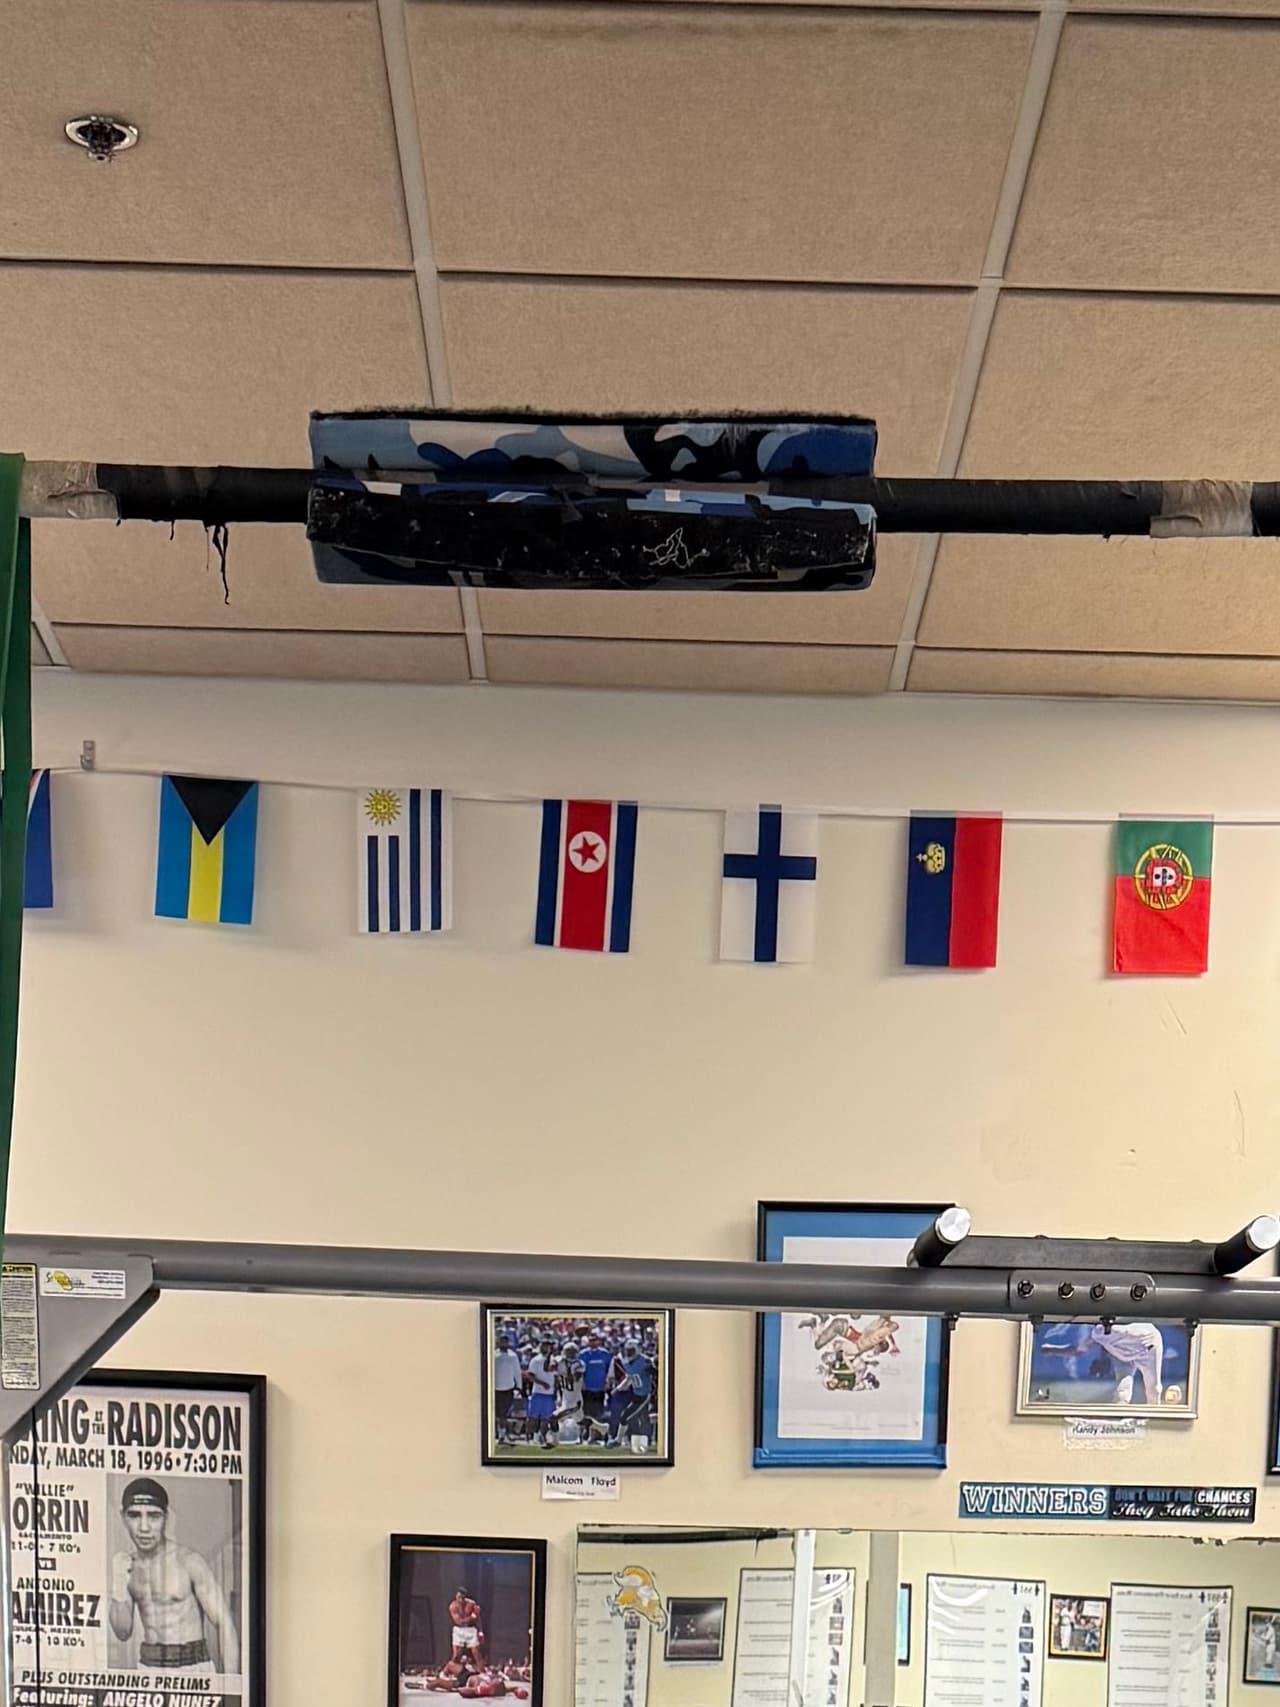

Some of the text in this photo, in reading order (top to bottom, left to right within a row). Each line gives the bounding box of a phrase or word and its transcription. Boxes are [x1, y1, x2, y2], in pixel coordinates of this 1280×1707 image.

[107, 1401, 241, 1451] RADISSON
[56, 1449, 104, 1468] MARCH
[111, 1450, 131, 1473] 18,
[221, 1454, 242, 1474] PM
[545, 1475, 616, 1488] Malcom Floyd
[963, 1487, 1107, 1514] WINNERS
[1198, 1490, 1251, 1504] CHANCES
[1113, 1503, 1249, 1519] They Take Them
[49, 1543, 55, 1551] 7
[22, 1671, 211, 1690] PLUS OUTSTANDING PRELIMS
[103, 1691, 164, 1707] ANGELO
